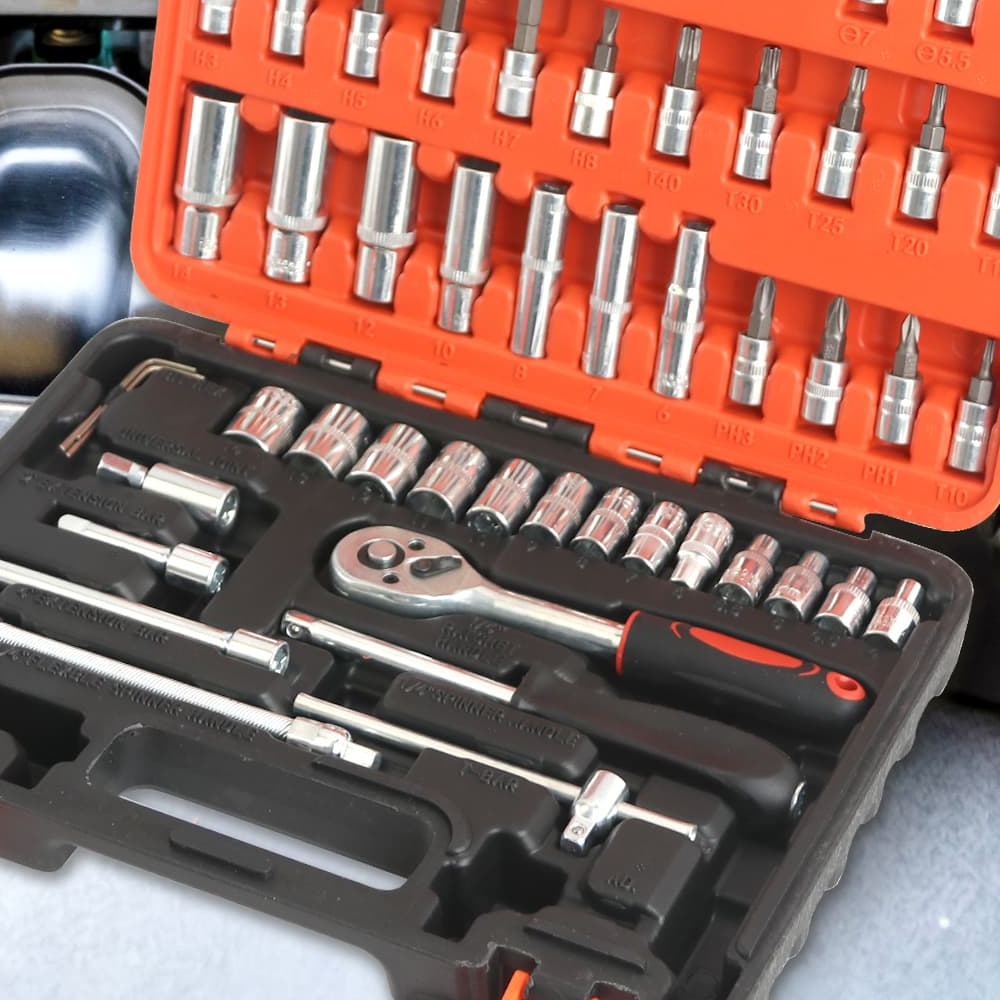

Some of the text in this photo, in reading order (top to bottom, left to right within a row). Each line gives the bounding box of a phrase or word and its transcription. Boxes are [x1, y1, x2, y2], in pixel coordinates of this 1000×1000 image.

[267, 69, 294, 90] H4
[341, 88, 367, 110] H5
[418, 109, 444, 130] H6
[494, 127, 521, 148] H7
[571, 149, 598, 170] H8
[647, 168, 682, 193] T40
[725, 190, 763, 214] T30
[808, 212, 845, 235] T25
[891, 234, 929, 257] T20
[266, 291, 288, 309] 13
[715, 422, 756, 447] PH3
[788, 443, 830, 469] PH2
[862, 463, 899, 488] PH1
[935, 482, 969, 507] T10
